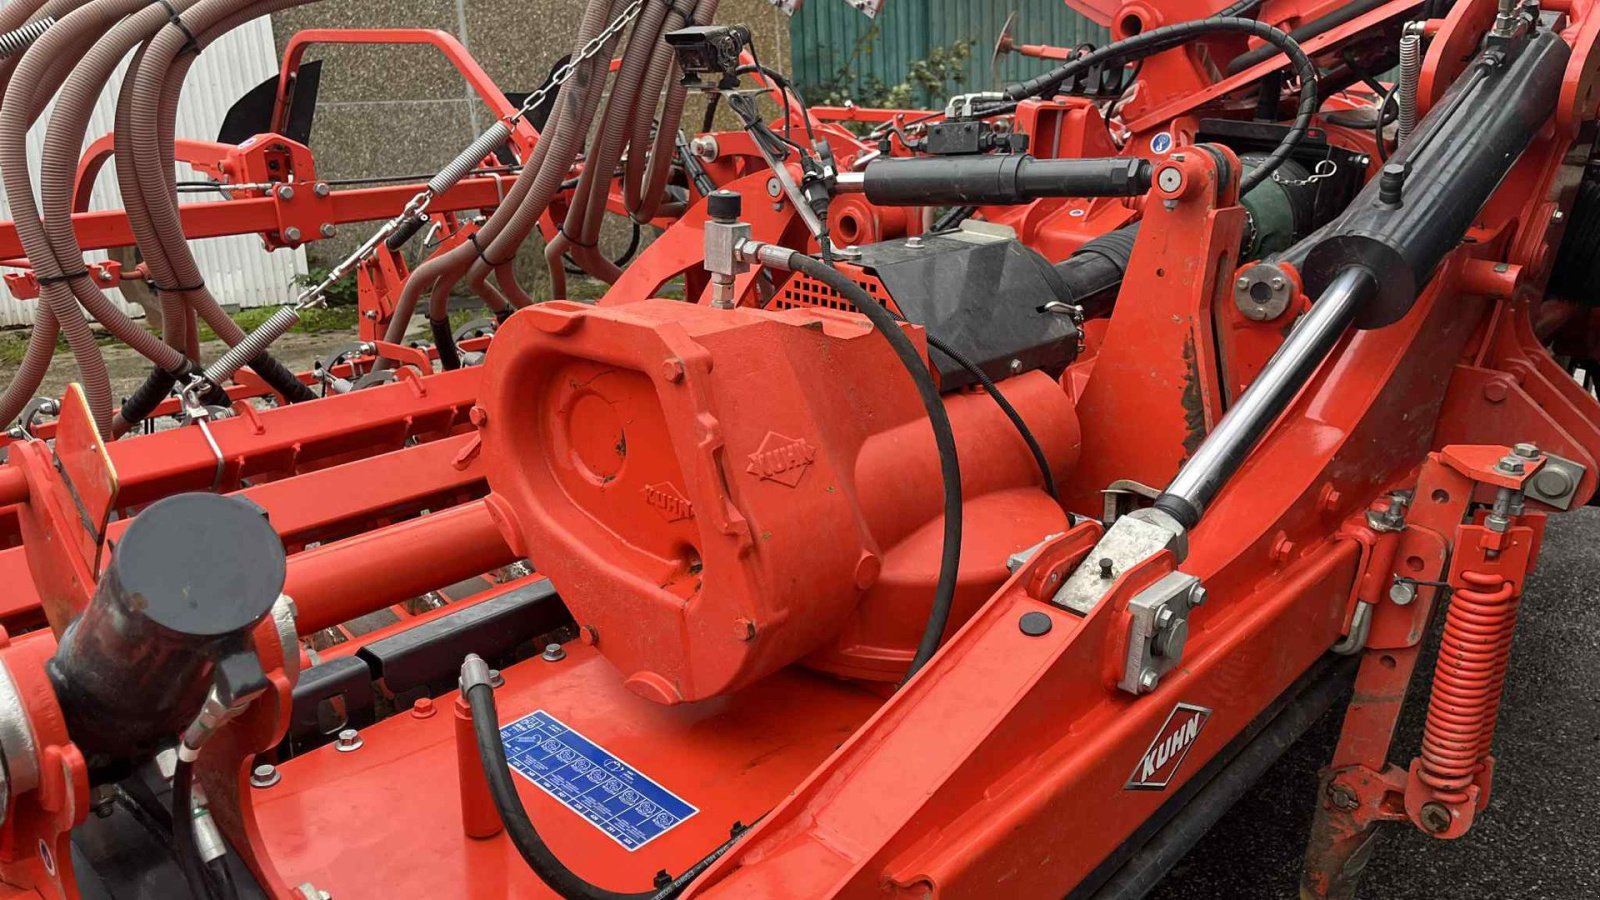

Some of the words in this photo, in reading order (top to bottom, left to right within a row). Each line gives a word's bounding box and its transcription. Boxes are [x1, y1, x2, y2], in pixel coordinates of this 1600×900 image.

[747, 438, 816, 480] KUHN
[643, 484, 695, 518] KUHN
[1141, 711, 1200, 784] KUHN
